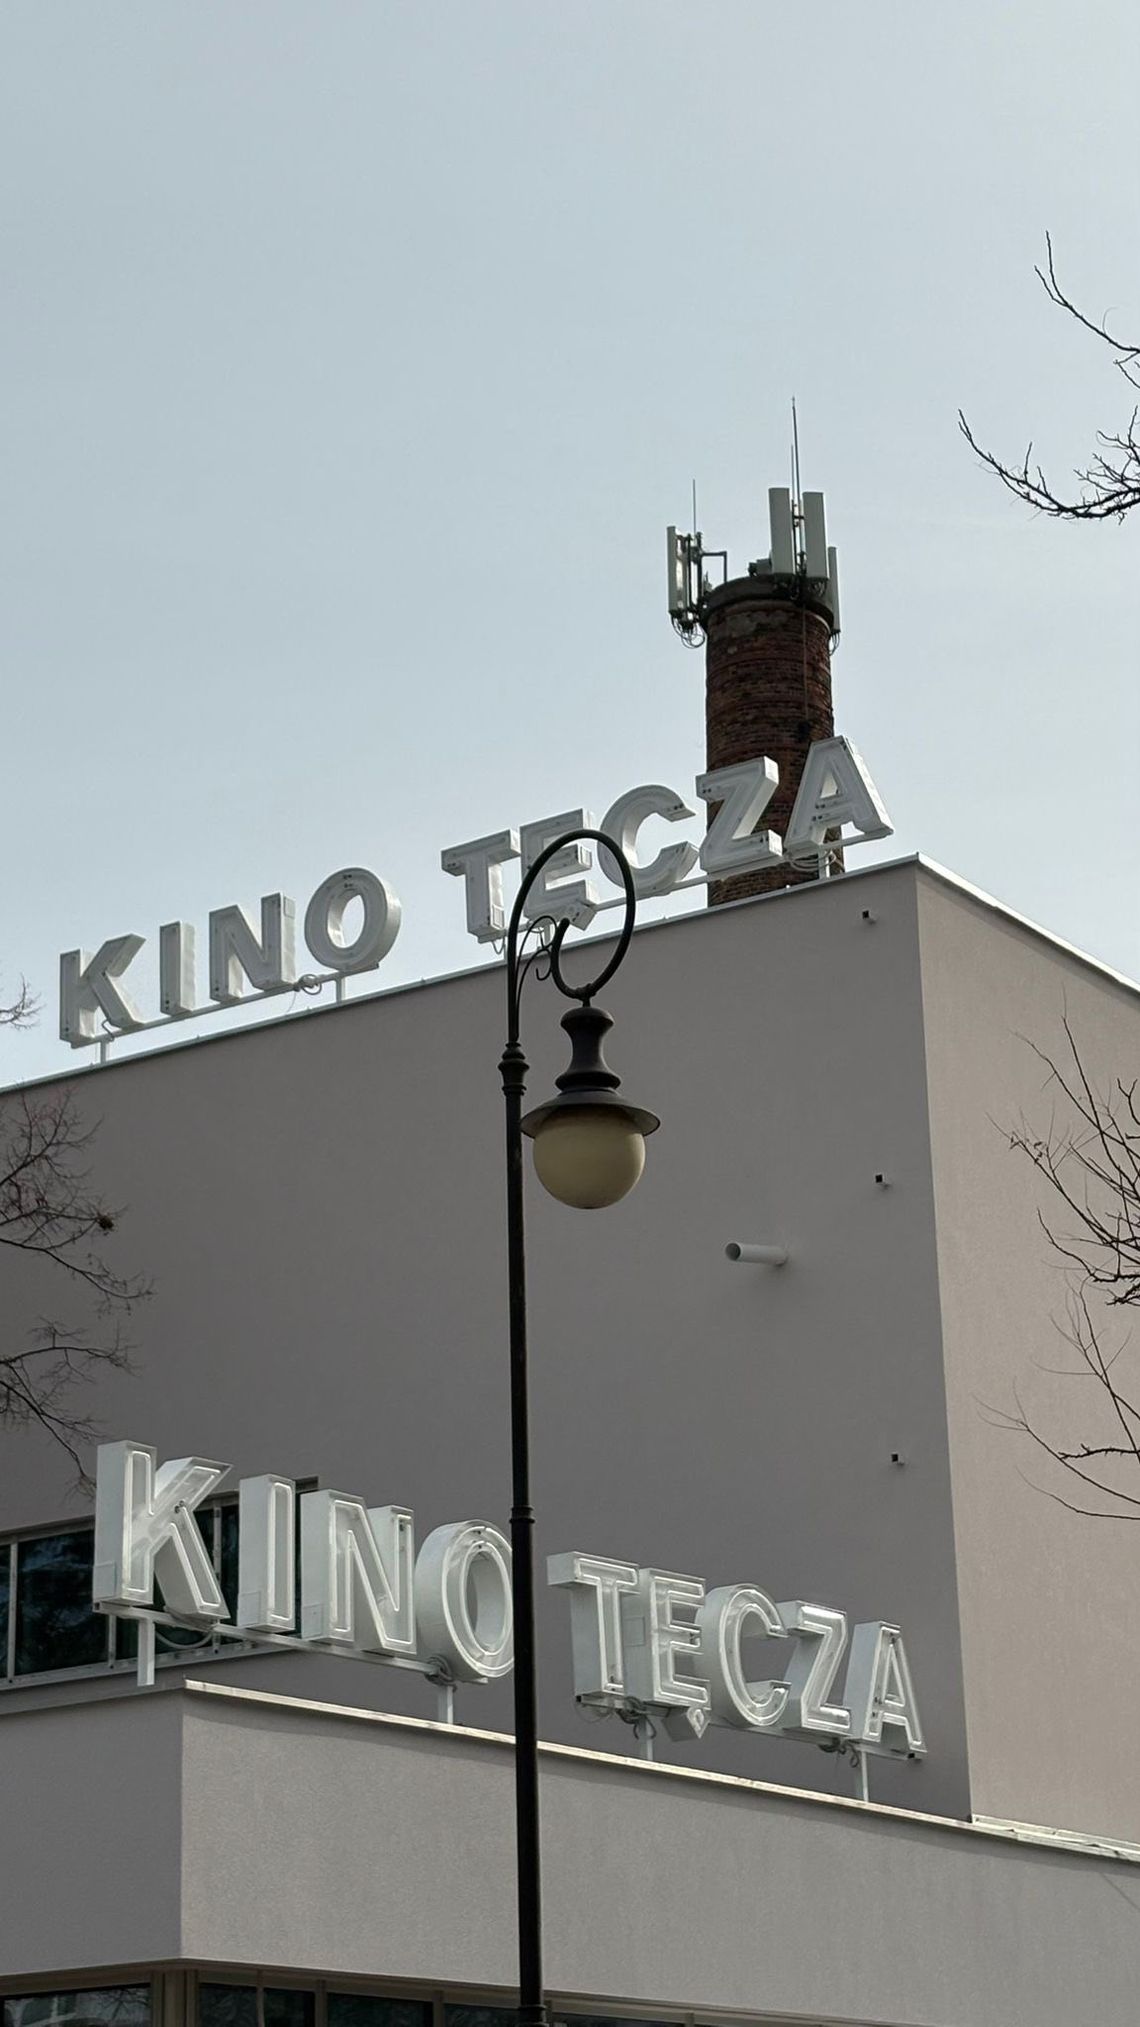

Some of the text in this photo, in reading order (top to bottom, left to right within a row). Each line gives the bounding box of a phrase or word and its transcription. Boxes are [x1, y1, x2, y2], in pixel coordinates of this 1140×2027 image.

[60, 735, 894, 1043] KINO TĘCZA
[93, 1440, 927, 1753] KINO TĘCZA
